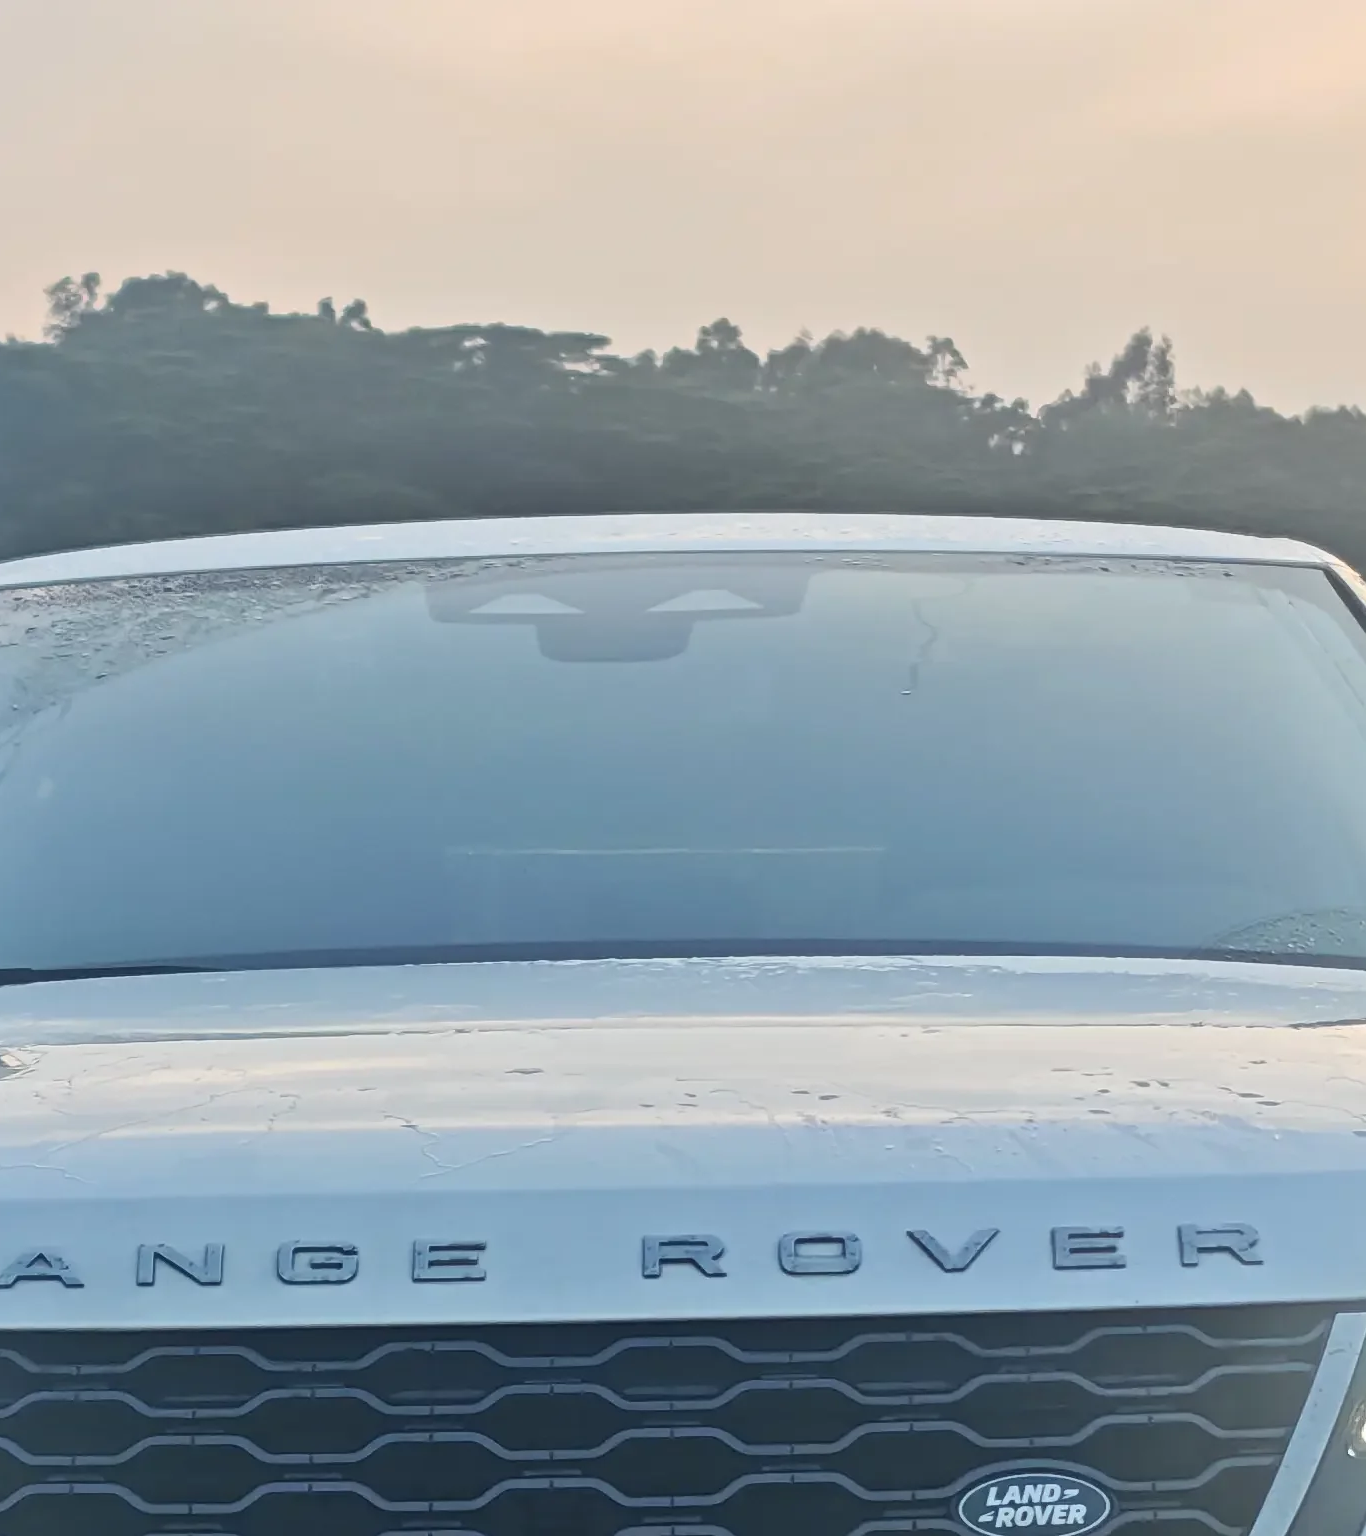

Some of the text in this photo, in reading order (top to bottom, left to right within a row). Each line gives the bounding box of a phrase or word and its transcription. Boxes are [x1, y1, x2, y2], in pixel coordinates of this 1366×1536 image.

[639, 1222, 1267, 1280] ROVER
[986, 1484, 1062, 1506] LAND
[995, 1504, 1087, 1528] ROVER
